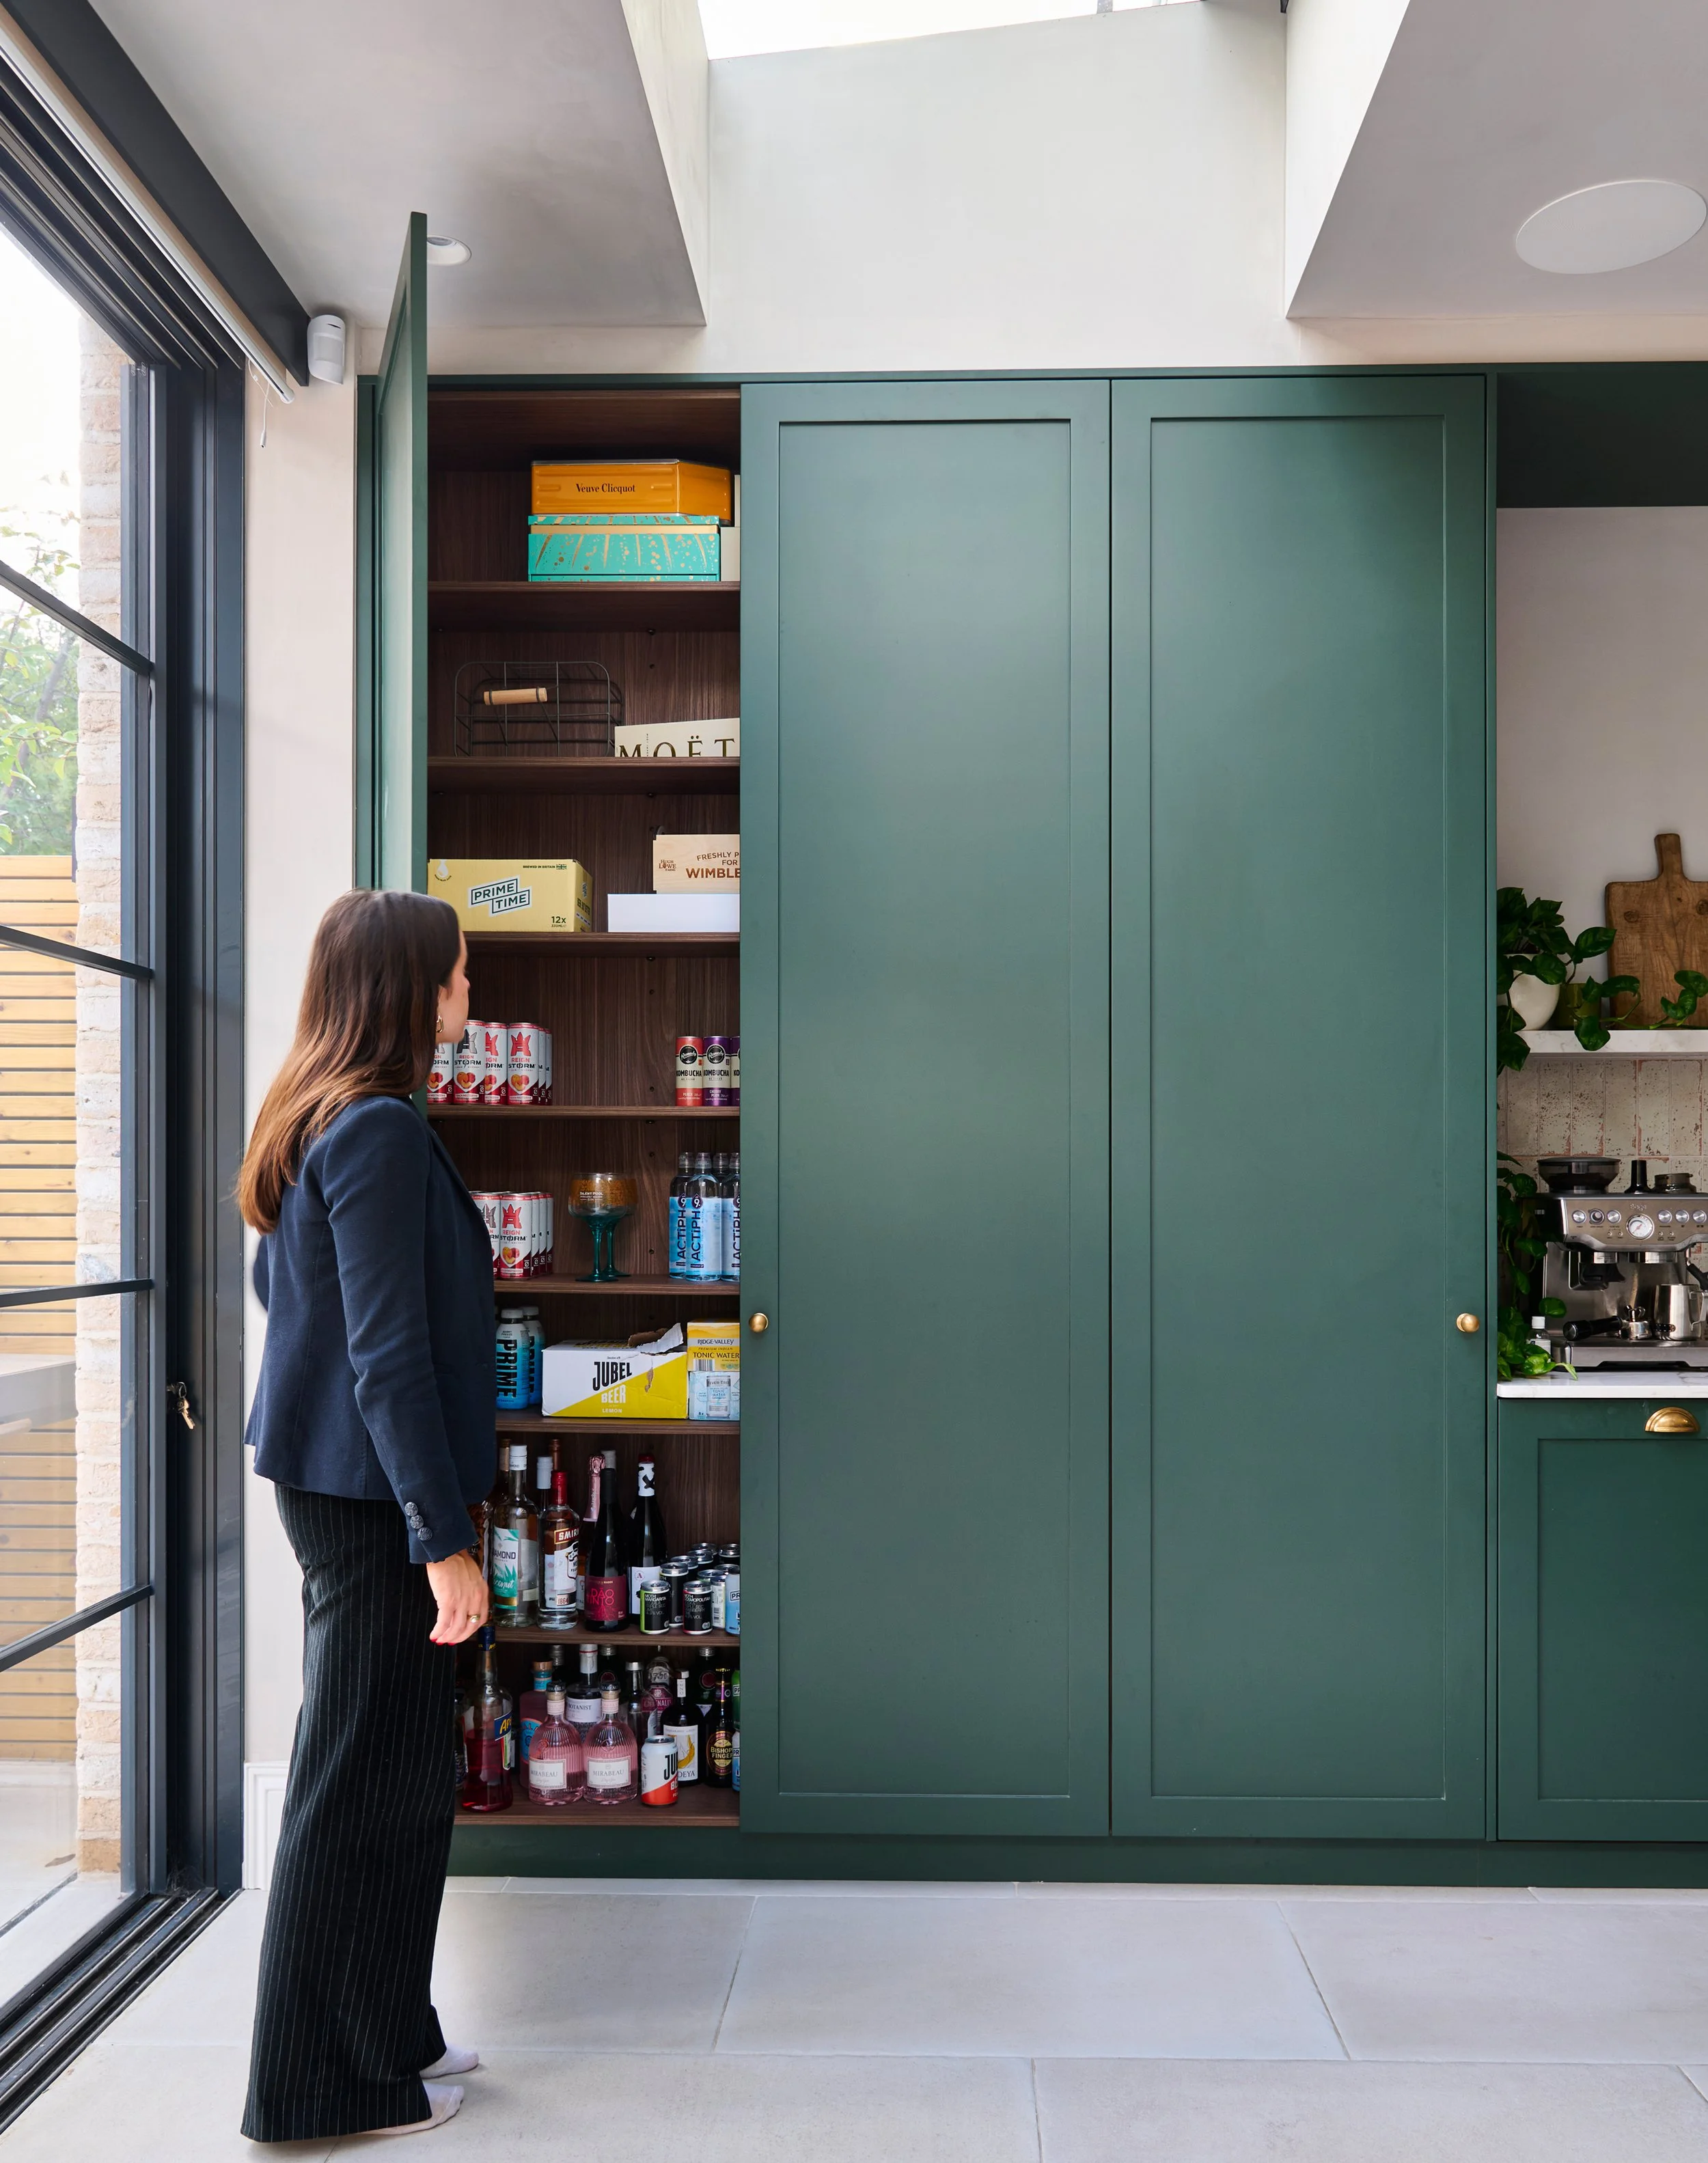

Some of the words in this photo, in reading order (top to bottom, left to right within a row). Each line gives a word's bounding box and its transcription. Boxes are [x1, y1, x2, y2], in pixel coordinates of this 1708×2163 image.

[576, 483, 599, 493] Veuve
[601, 482, 635, 495] Clicquot
[697, 852, 732, 861] FRESHLY
[475, 883, 514, 900] PRIME
[495, 894, 527, 909] TIME
[496, 1339, 518, 1398] PRIME
[592, 1361, 632, 1391] JUBEL
[601, 1384, 626, 1403] BEER
[592, 1769, 624, 1777] MIRABEAU
